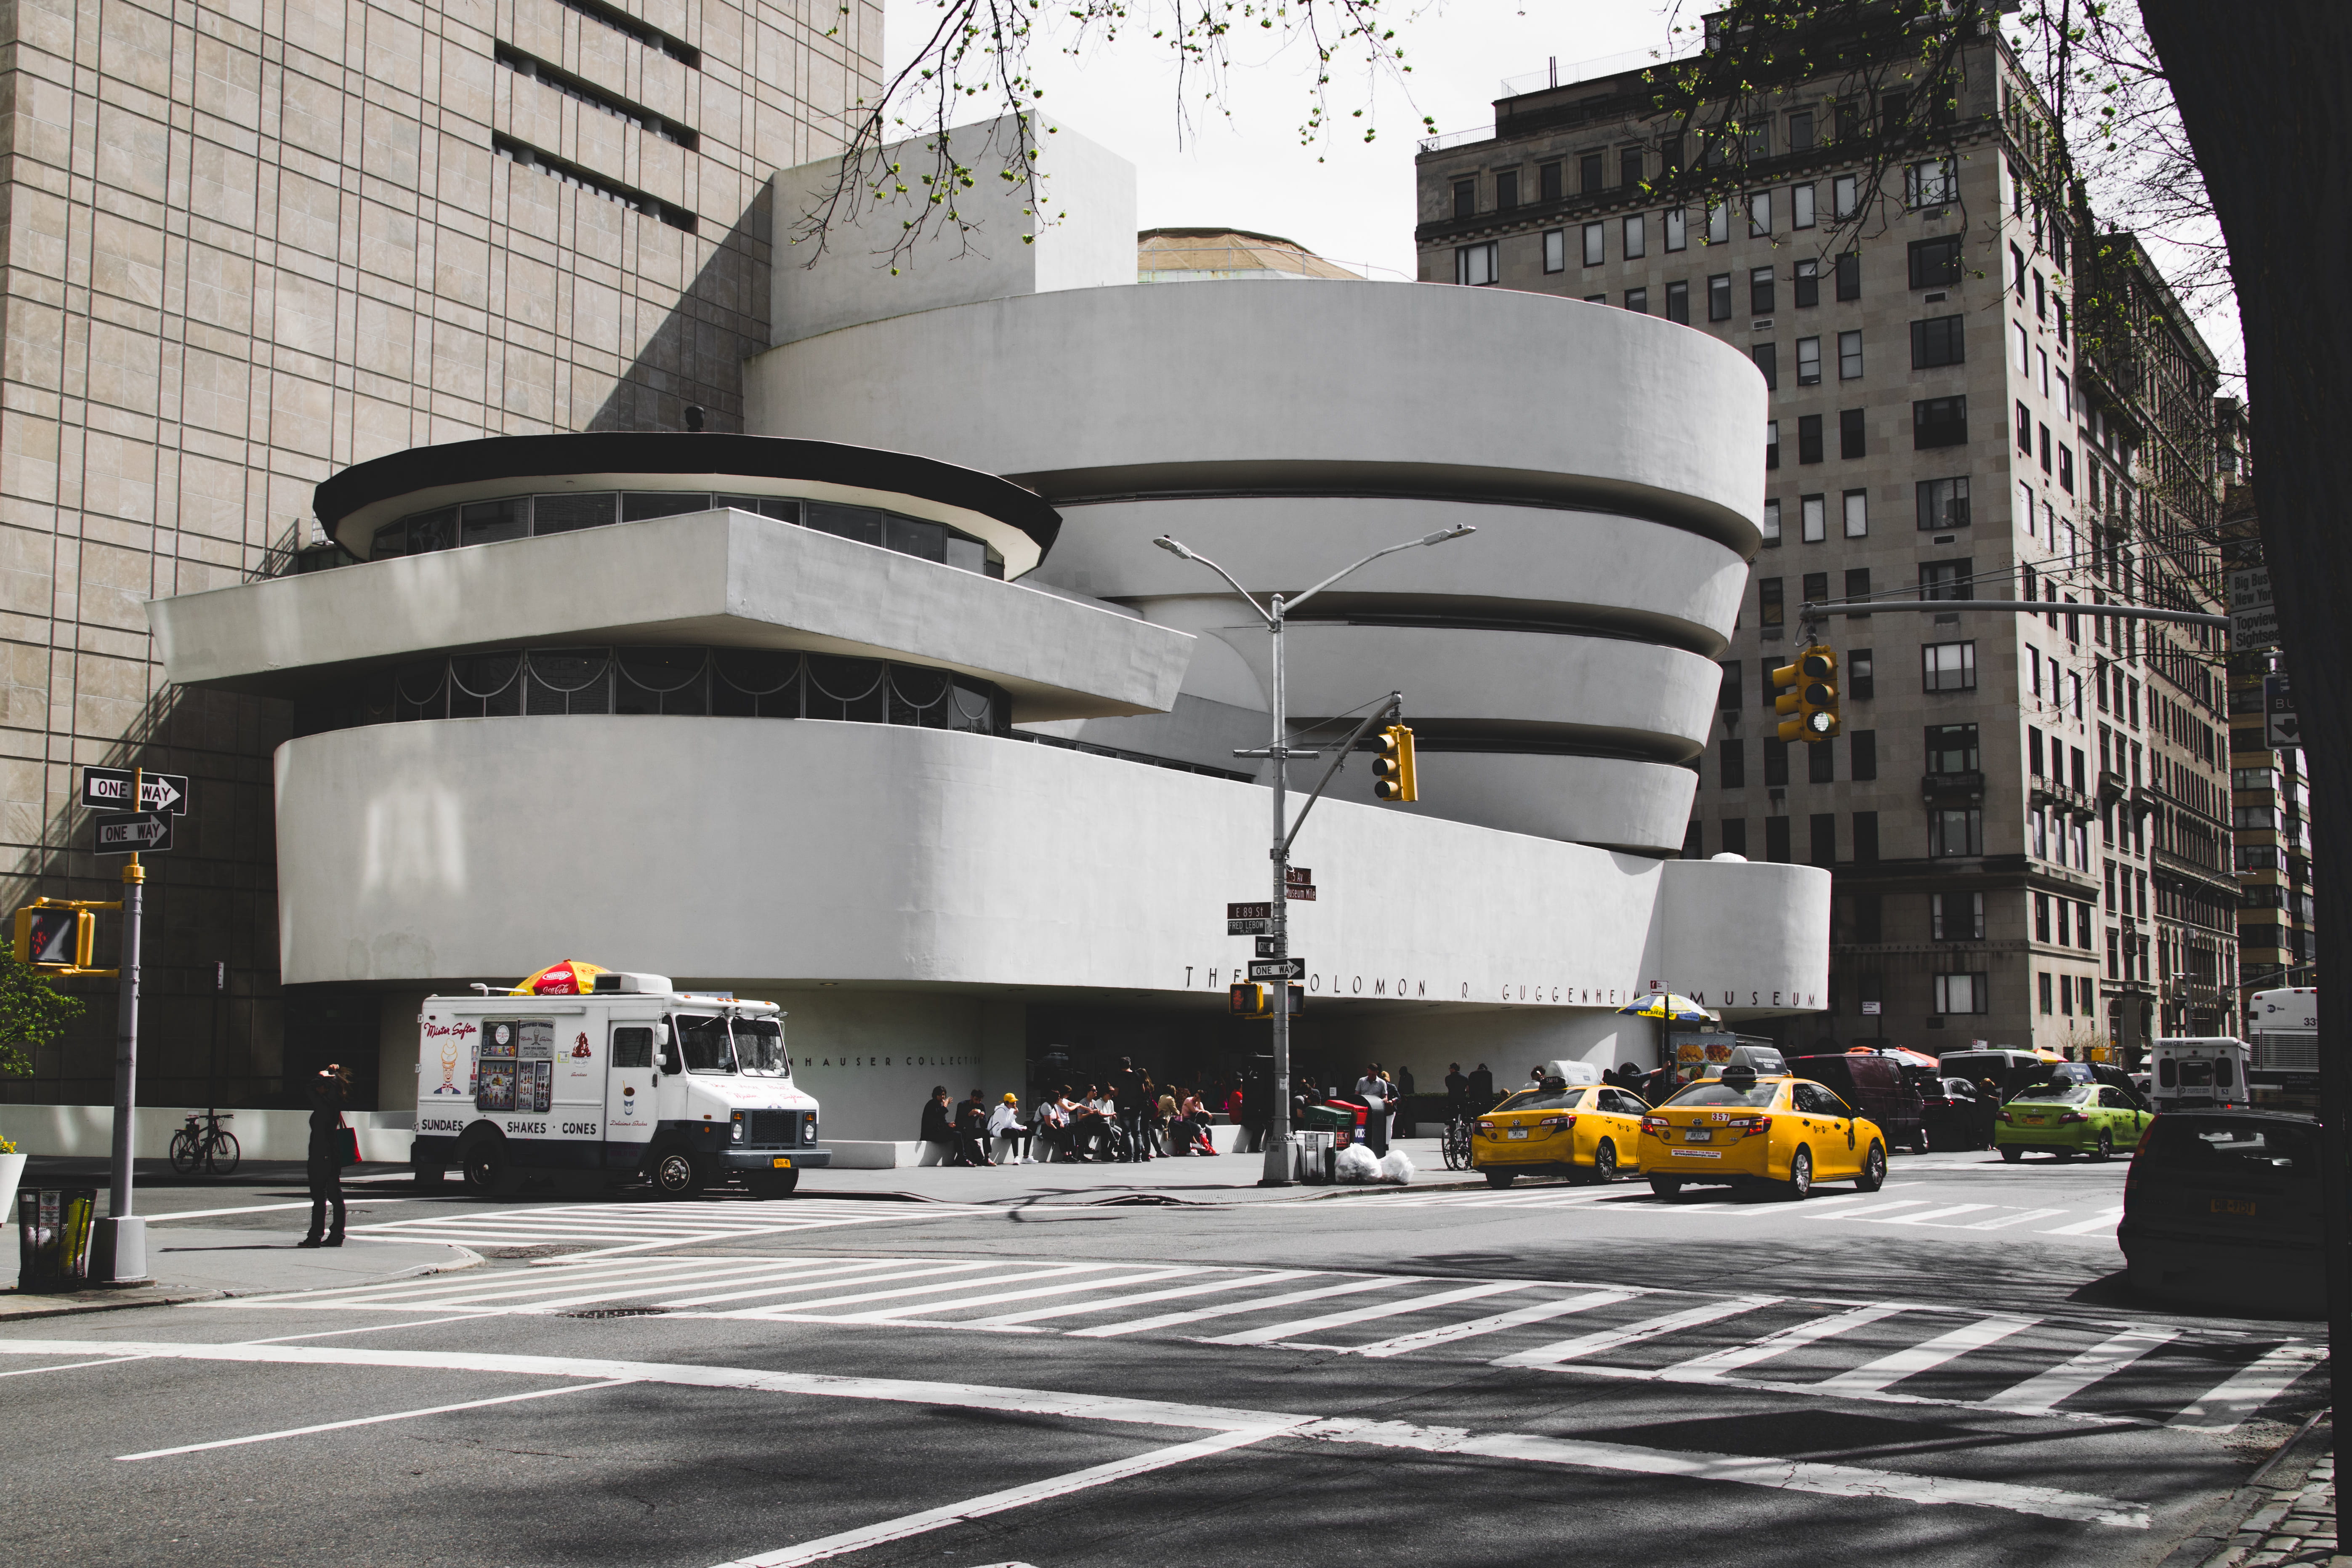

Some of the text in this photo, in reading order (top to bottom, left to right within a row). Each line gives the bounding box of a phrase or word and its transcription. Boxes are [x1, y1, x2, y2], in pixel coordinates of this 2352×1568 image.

[2235, 574, 2268, 591] Big Bus
[2235, 588, 2273, 606] New Yor
[2235, 629, 2280, 649] Sightsee
[2276, 698, 2294, 708] BU
[98, 780, 171, 801] ONE WAY
[106, 823, 160, 841] ONE WAY
[1293, 871, 1303, 882] 5 Av
[1286, 888, 1316, 899] Museum Mile
[1236, 907, 1263, 917] E 89 St
[1229, 921, 1264, 930] FRED LEBOW
[1260, 942, 1270, 952] ONE
[1256, 965, 1295, 975] ONE WAY
[543, 983, 569, 994] Coca-Cola
[1310, 973, 1425, 997] OLOMON
[1462, 982, 1468, 999] R
[1690, 990, 1815, 1006] MUSEUM
[424, 1022, 450, 1038] Mister
[452, 1022, 477, 1040] Softee
[906, 1056, 981, 1066] COLLECTION
[422, 1119, 596, 1135] SUNDAES SHAKES CONES
[1354, 1128, 1365, 1138] VOICE
